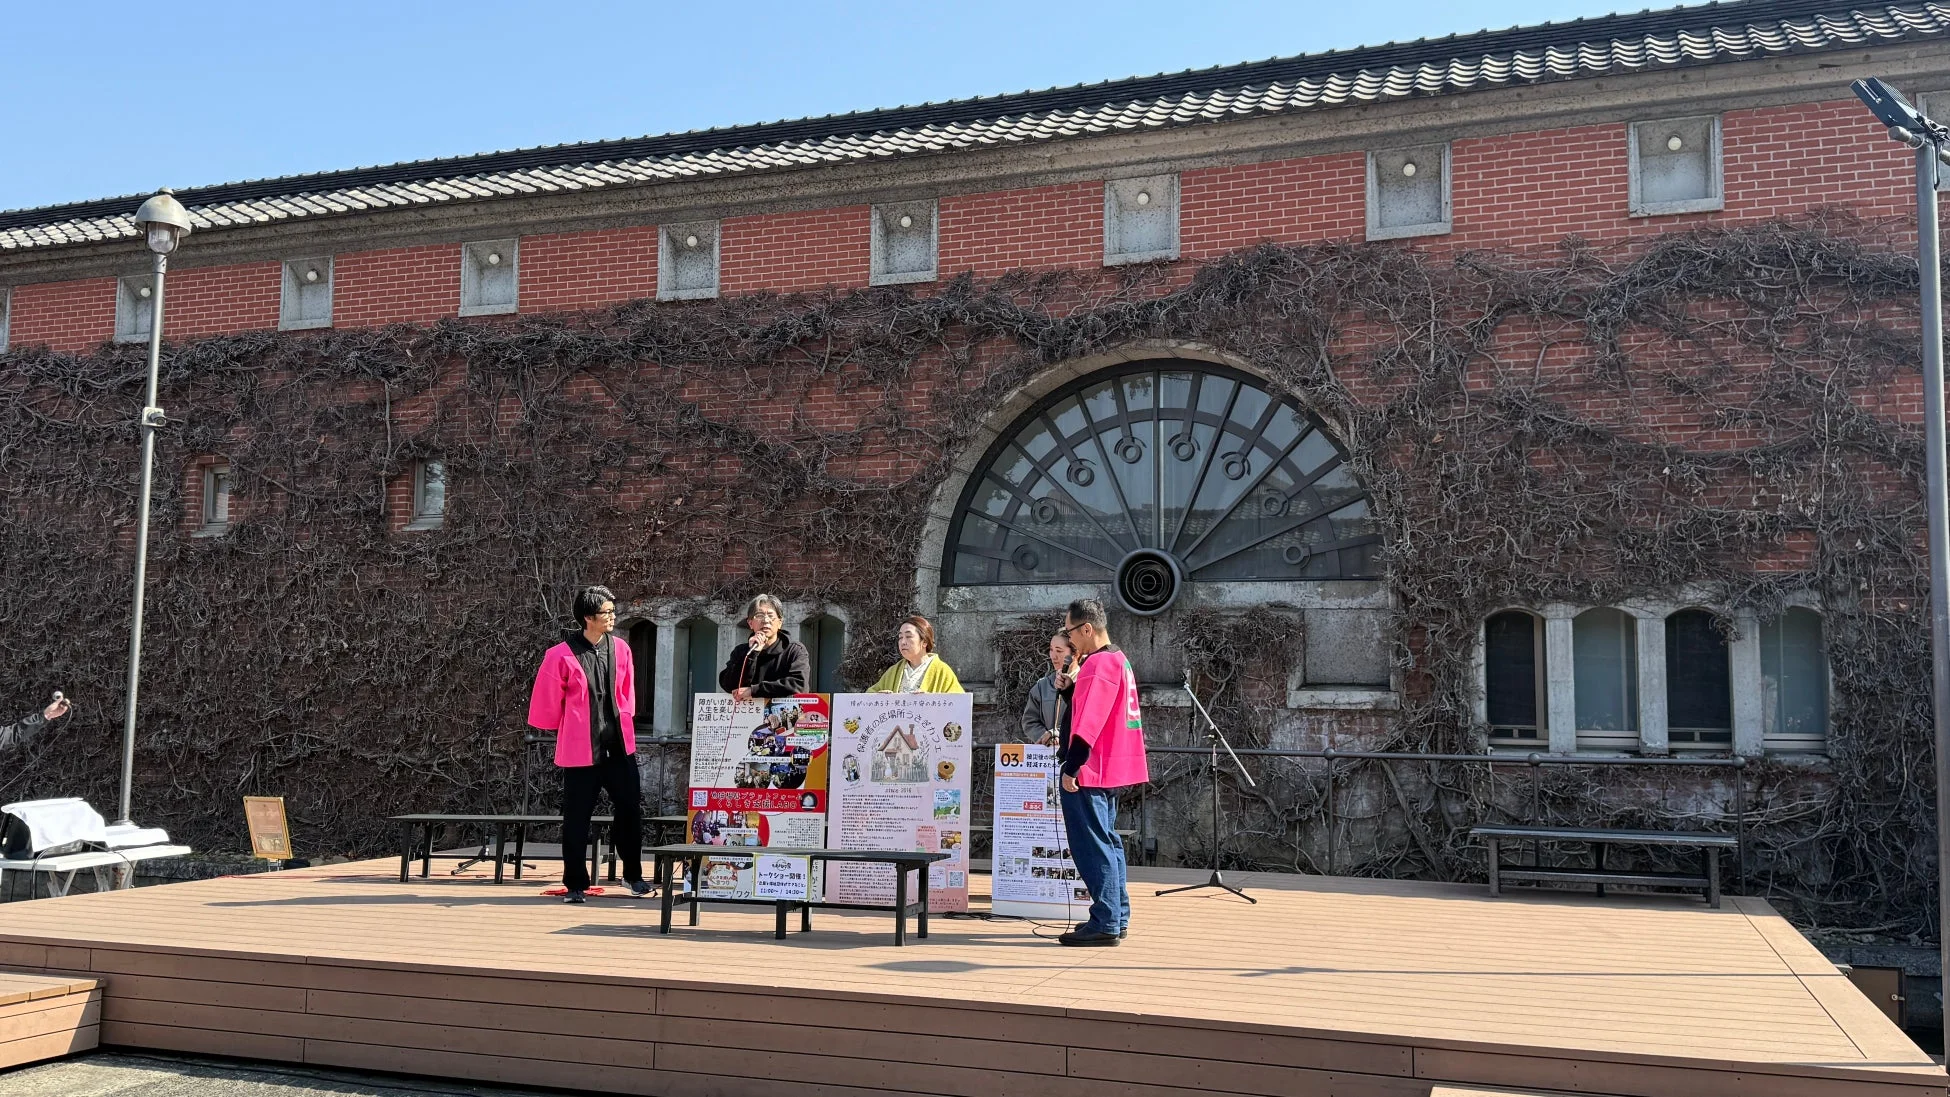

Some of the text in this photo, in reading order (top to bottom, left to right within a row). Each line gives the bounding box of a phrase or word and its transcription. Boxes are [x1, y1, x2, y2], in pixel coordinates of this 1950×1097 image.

[699, 698, 755, 706] 障がいがあっても
[1001, 753, 1023, 767] 03.
